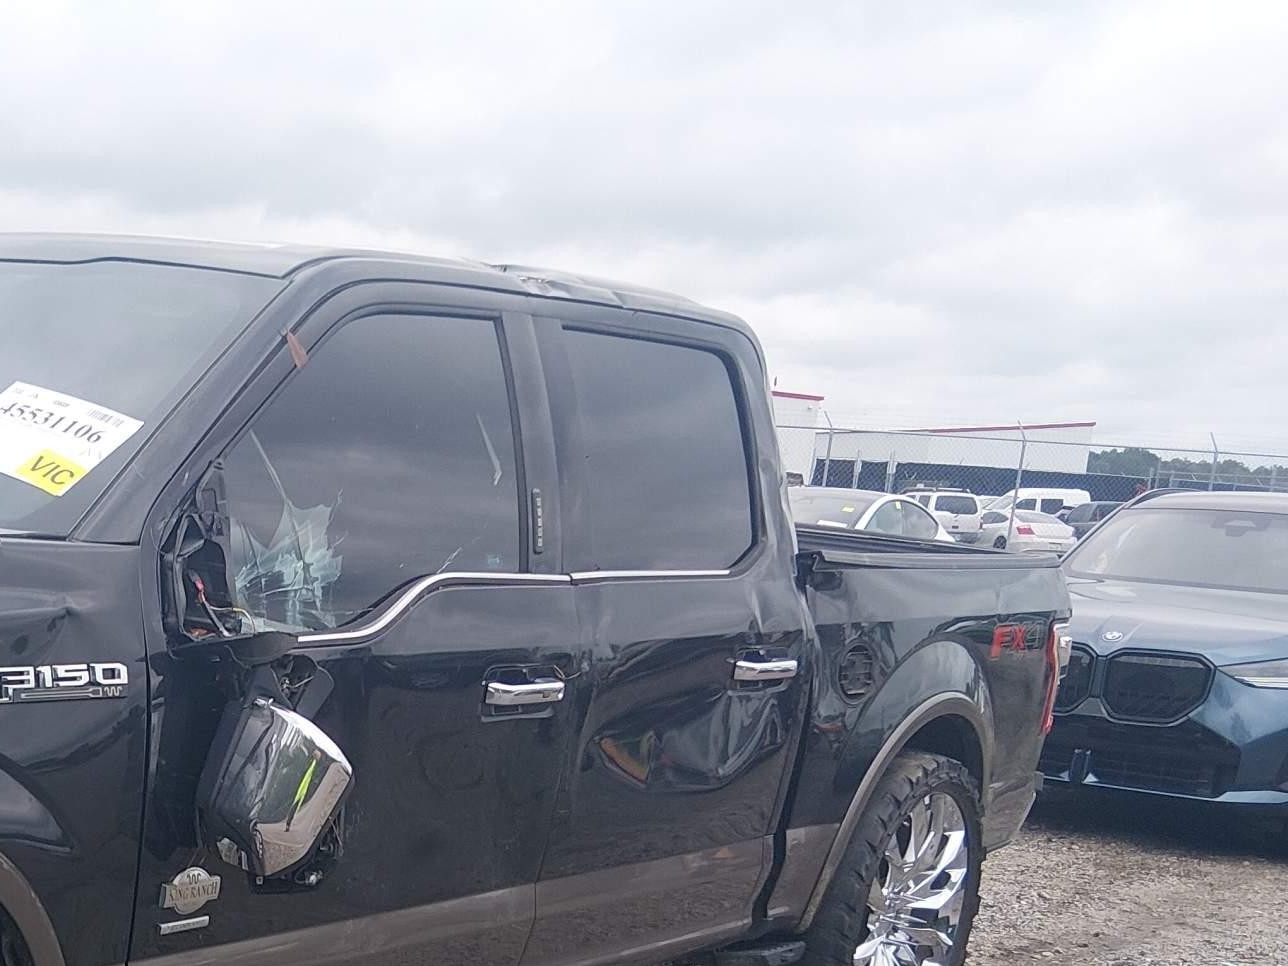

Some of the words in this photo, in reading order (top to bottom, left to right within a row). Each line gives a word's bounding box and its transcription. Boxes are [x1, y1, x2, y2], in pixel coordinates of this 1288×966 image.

[0, 401, 108, 444] 45531106
[29, 455, 75, 485] VIC
[989, 622, 1045, 661] FX4
[168, 886, 189, 903] KING
[190, 880, 218, 899] RANCH
